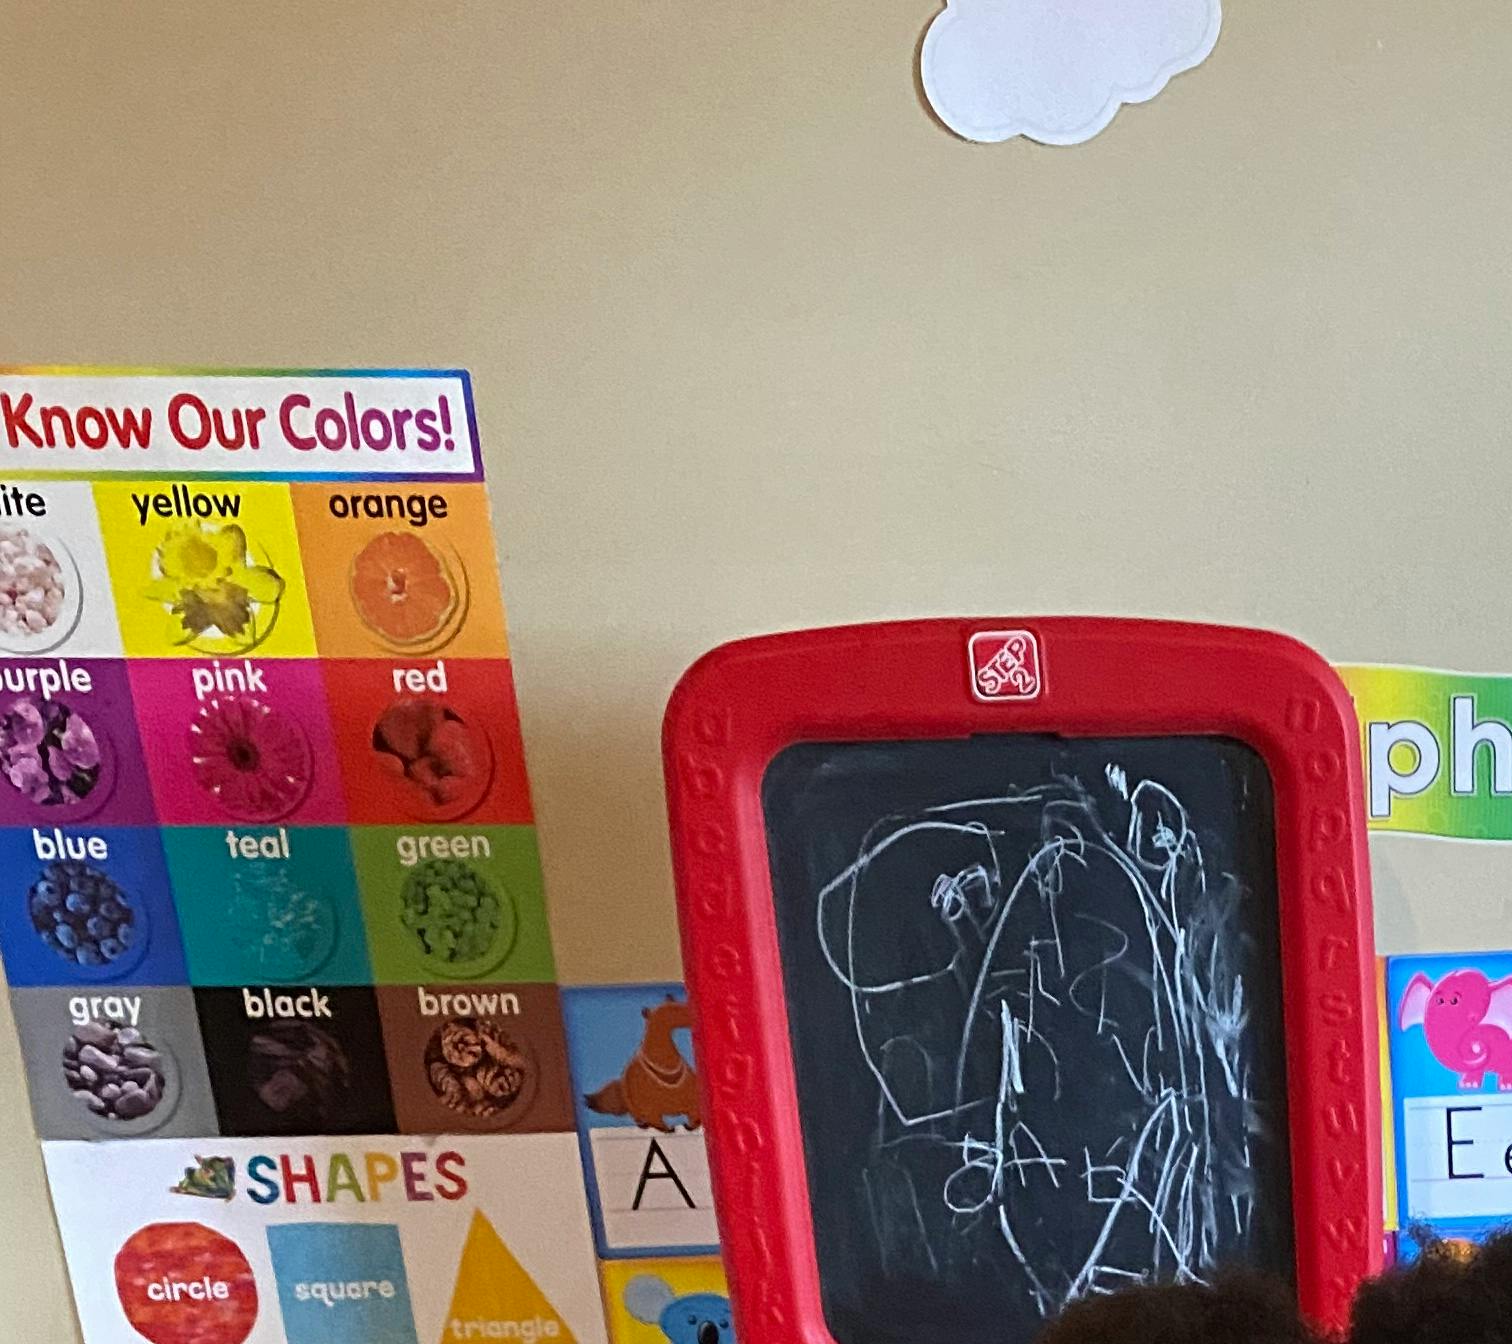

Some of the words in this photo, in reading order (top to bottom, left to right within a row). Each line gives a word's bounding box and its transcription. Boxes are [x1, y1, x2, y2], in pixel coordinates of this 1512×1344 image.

[3, 393, 151, 451] Know
[167, 394, 266, 451] Our
[280, 393, 455, 451] Colors!
[131, 489, 241, 527] yellow
[328, 490, 449, 526] orange
[192, 662, 267, 698] pink
[392, 662, 448, 694] red
[32, 830, 108, 860] blue
[225, 829, 290, 860] teal
[397, 831, 491, 864] green
[69, 991, 141, 1027] gray
[244, 988, 332, 1020] black
[417, 990, 520, 1018] brown
[247, 1151, 469, 1205] SHAPES
[147, 1276, 230, 1303] circle
[295, 1277, 395, 1306] square
[450, 1315, 560, 1342] triangle
